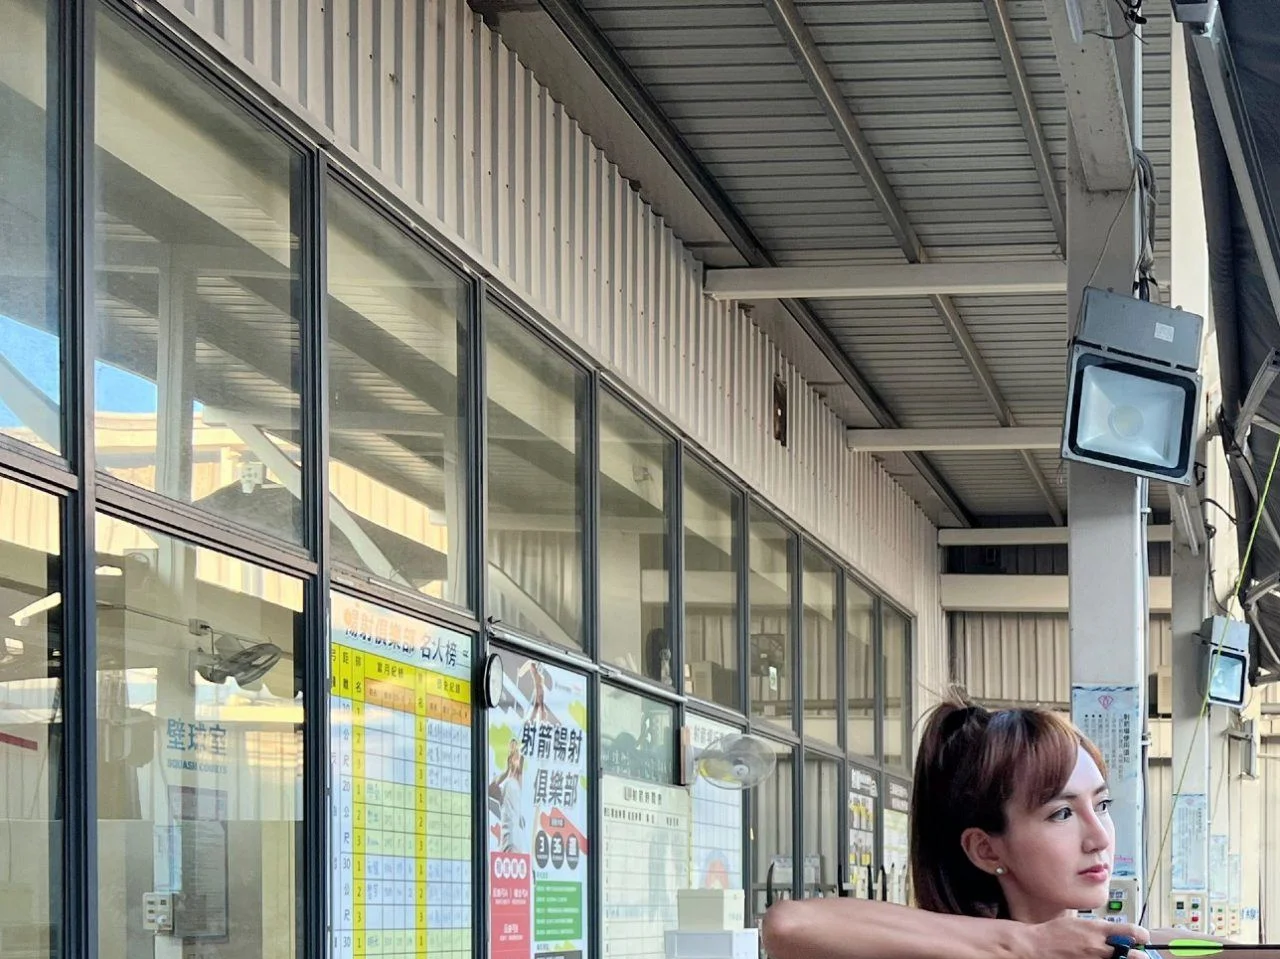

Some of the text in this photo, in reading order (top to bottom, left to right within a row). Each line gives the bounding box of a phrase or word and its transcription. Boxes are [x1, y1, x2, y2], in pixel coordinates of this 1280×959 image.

[421, 636, 457, 667] 名人榜
[167, 718, 227, 756] 壁球室
[521, 720, 583, 763] 射箭暢射
[534, 769, 579, 806] 俱樂部
